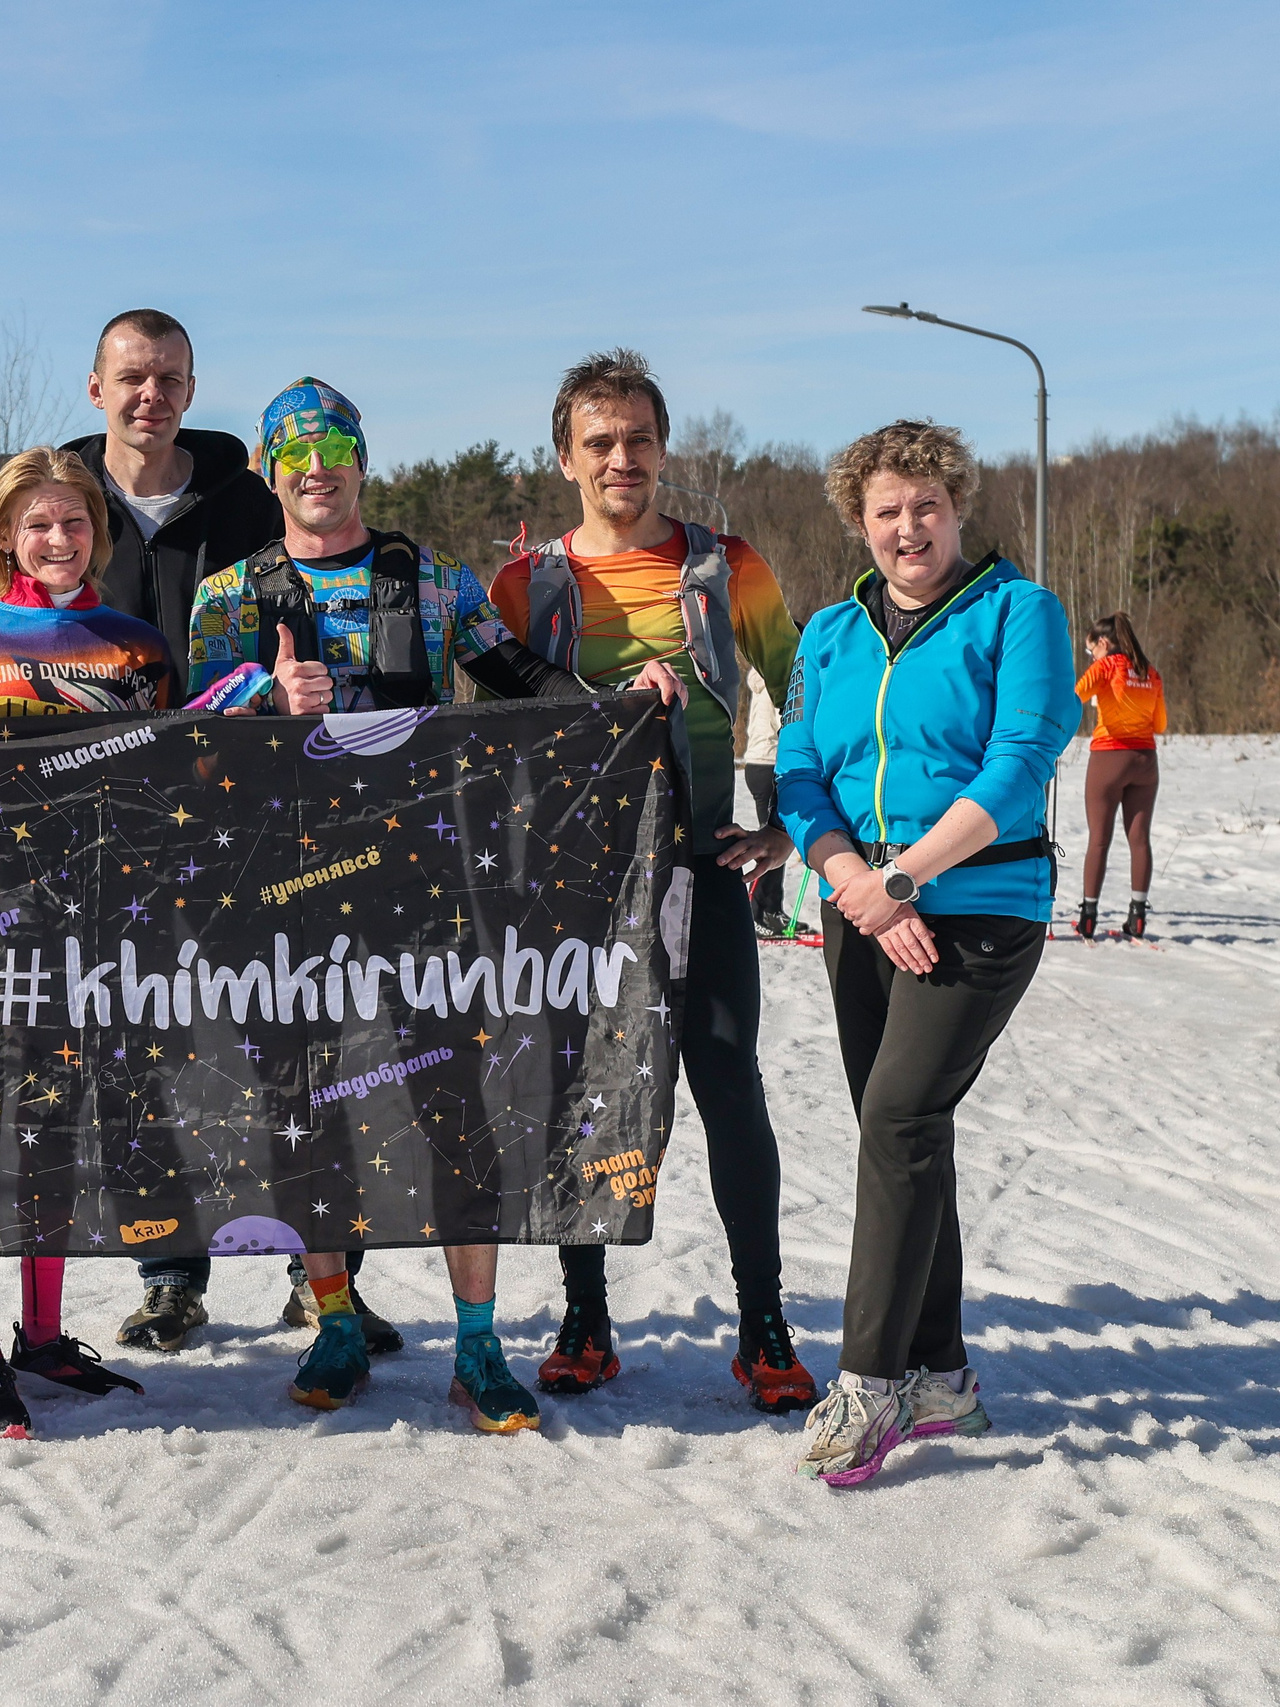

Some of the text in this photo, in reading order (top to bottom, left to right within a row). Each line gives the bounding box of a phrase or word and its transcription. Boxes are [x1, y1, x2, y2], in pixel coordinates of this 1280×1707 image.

[39, 726, 157, 779] #щастак
[259, 845, 382, 906] #уменявсё
[310, 1045, 455, 1109] #надобрать
[581, 1148, 646, 1183] #чат
[133, 1222, 166, 1239] KRB
